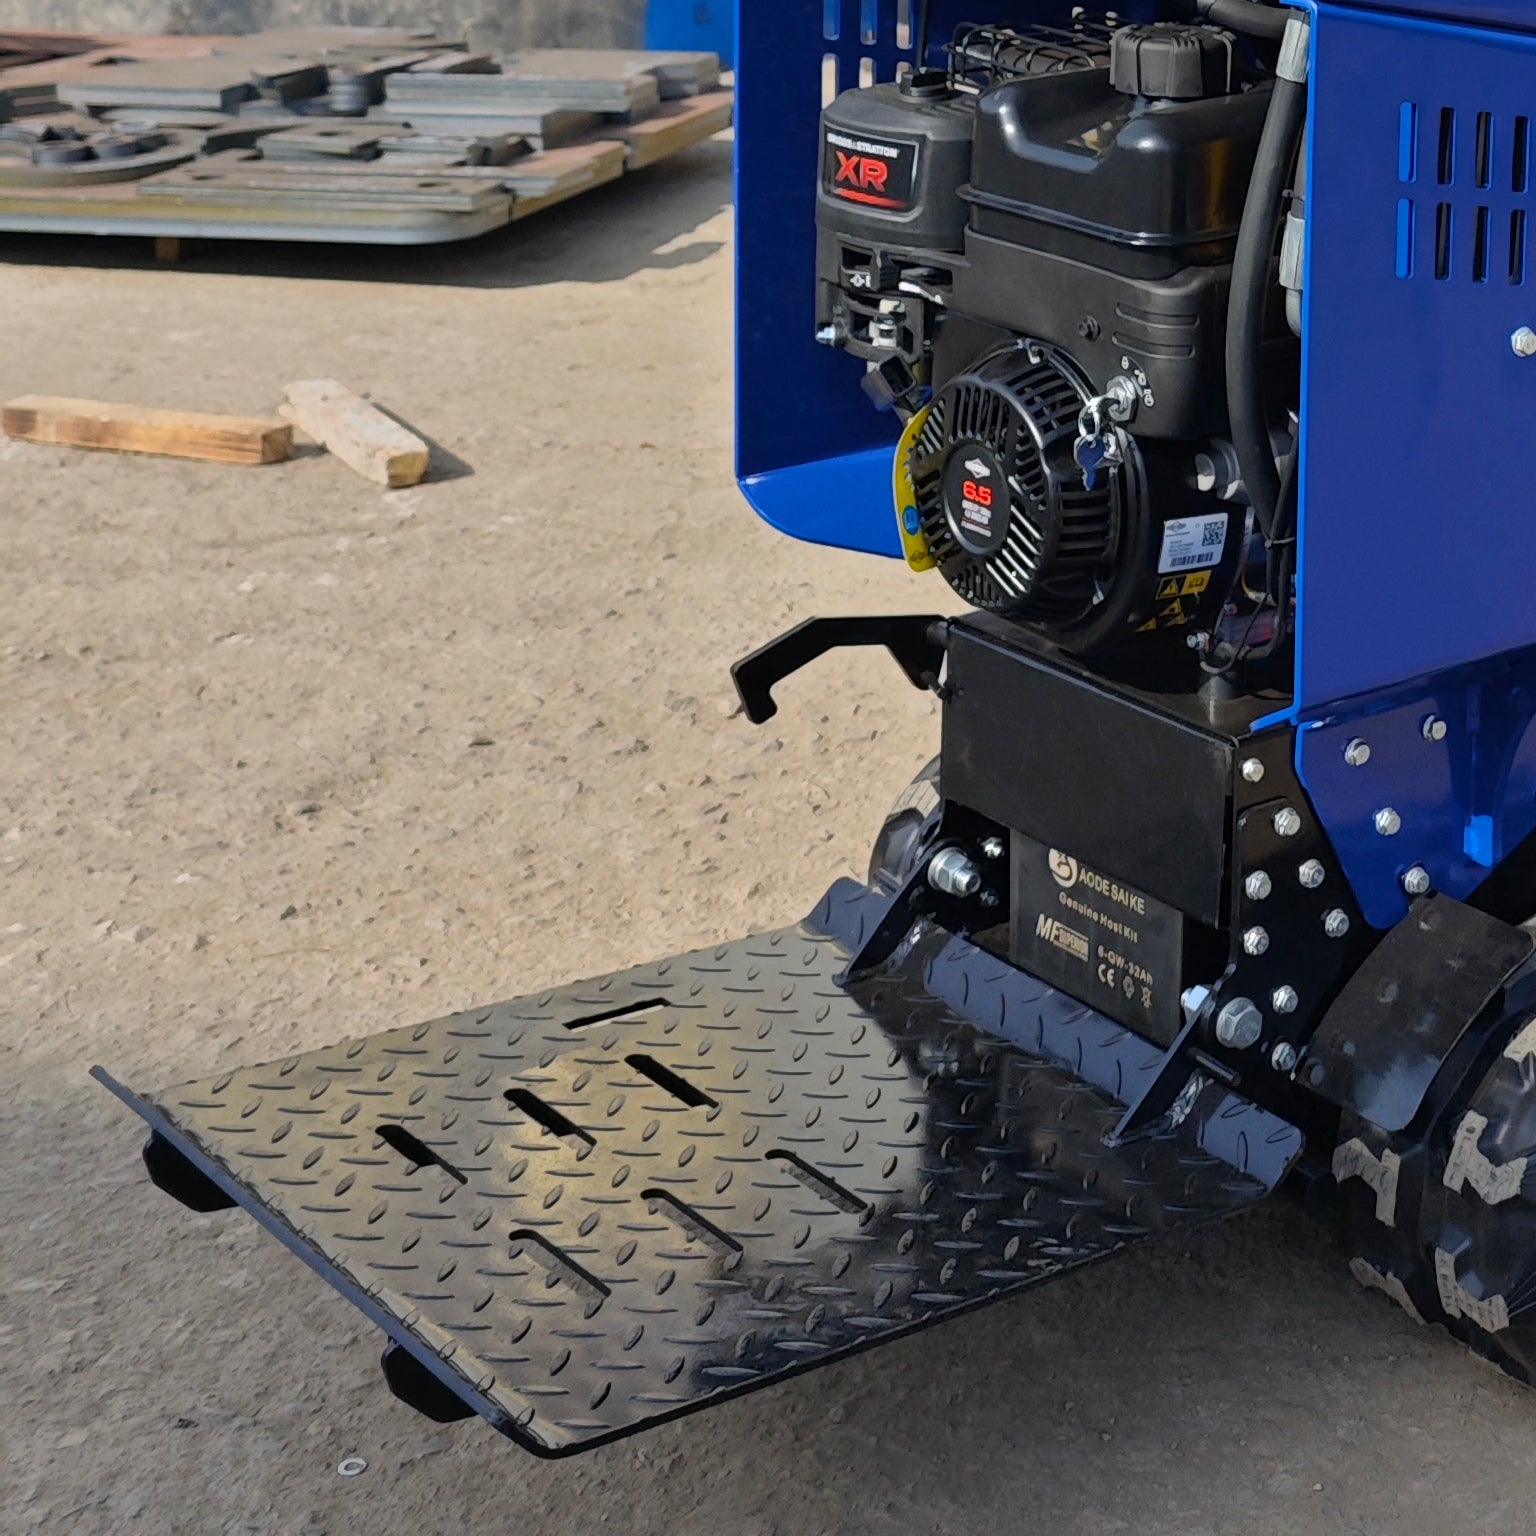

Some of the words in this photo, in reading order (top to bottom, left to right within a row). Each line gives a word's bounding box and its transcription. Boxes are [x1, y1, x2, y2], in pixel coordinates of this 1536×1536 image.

[835, 150, 888, 192] XR
[963, 480, 992, 506] 6.5
[1035, 913, 1060, 942] MF
[1059, 891, 1099, 922] Genuine
[1100, 912, 1123, 935] Host
[1123, 927, 1138, 944] Kit
